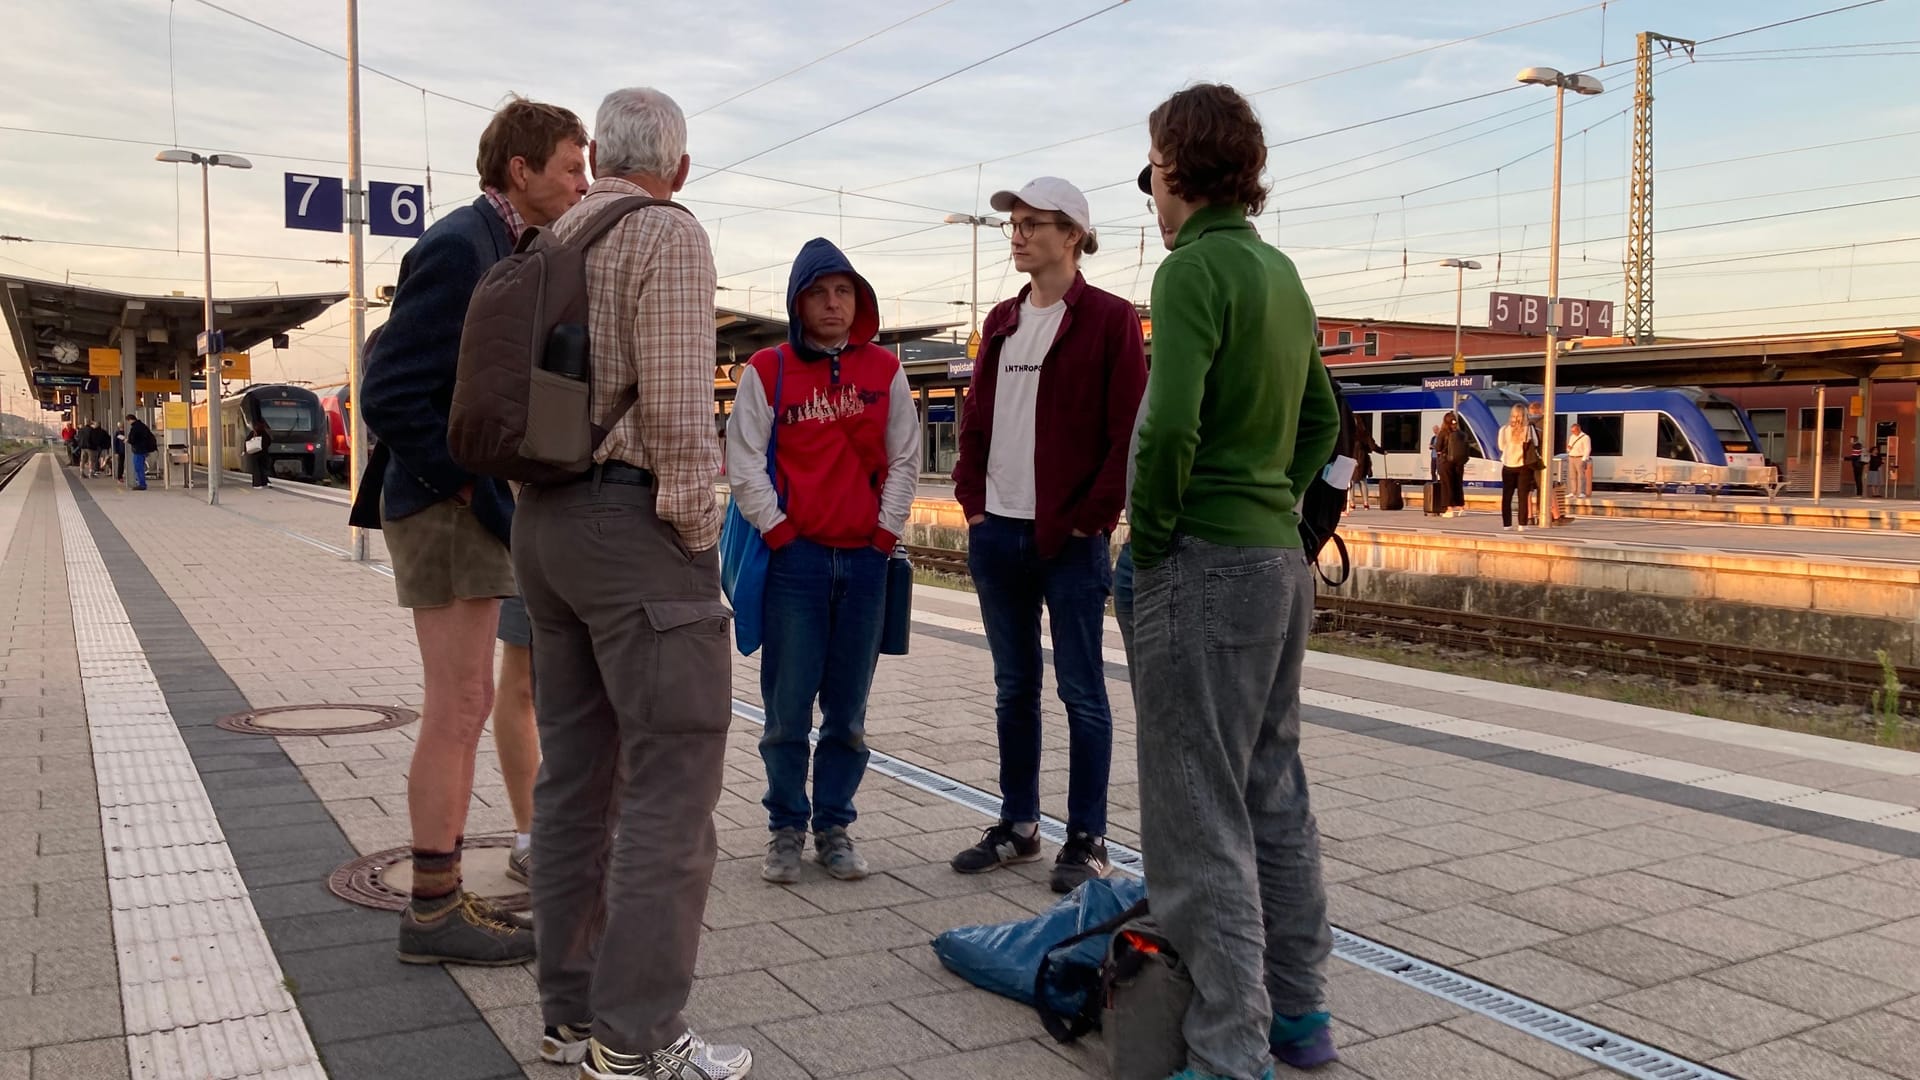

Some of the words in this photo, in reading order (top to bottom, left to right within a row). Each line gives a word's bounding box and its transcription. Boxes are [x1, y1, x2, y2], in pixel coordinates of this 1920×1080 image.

[292, 175, 319, 216] 7
[391, 185, 417, 225] 6
[1496, 296, 1509, 321] 5
[1524, 298, 1538, 324] B
[1571, 302, 1583, 327] B
[1598, 304, 1610, 329] 4
[82, 378, 92, 390] 7
[1424, 379, 1458, 389] Ingolstadt
[1460, 377, 1473, 386] Hbf
[64, 395, 72, 404] B
